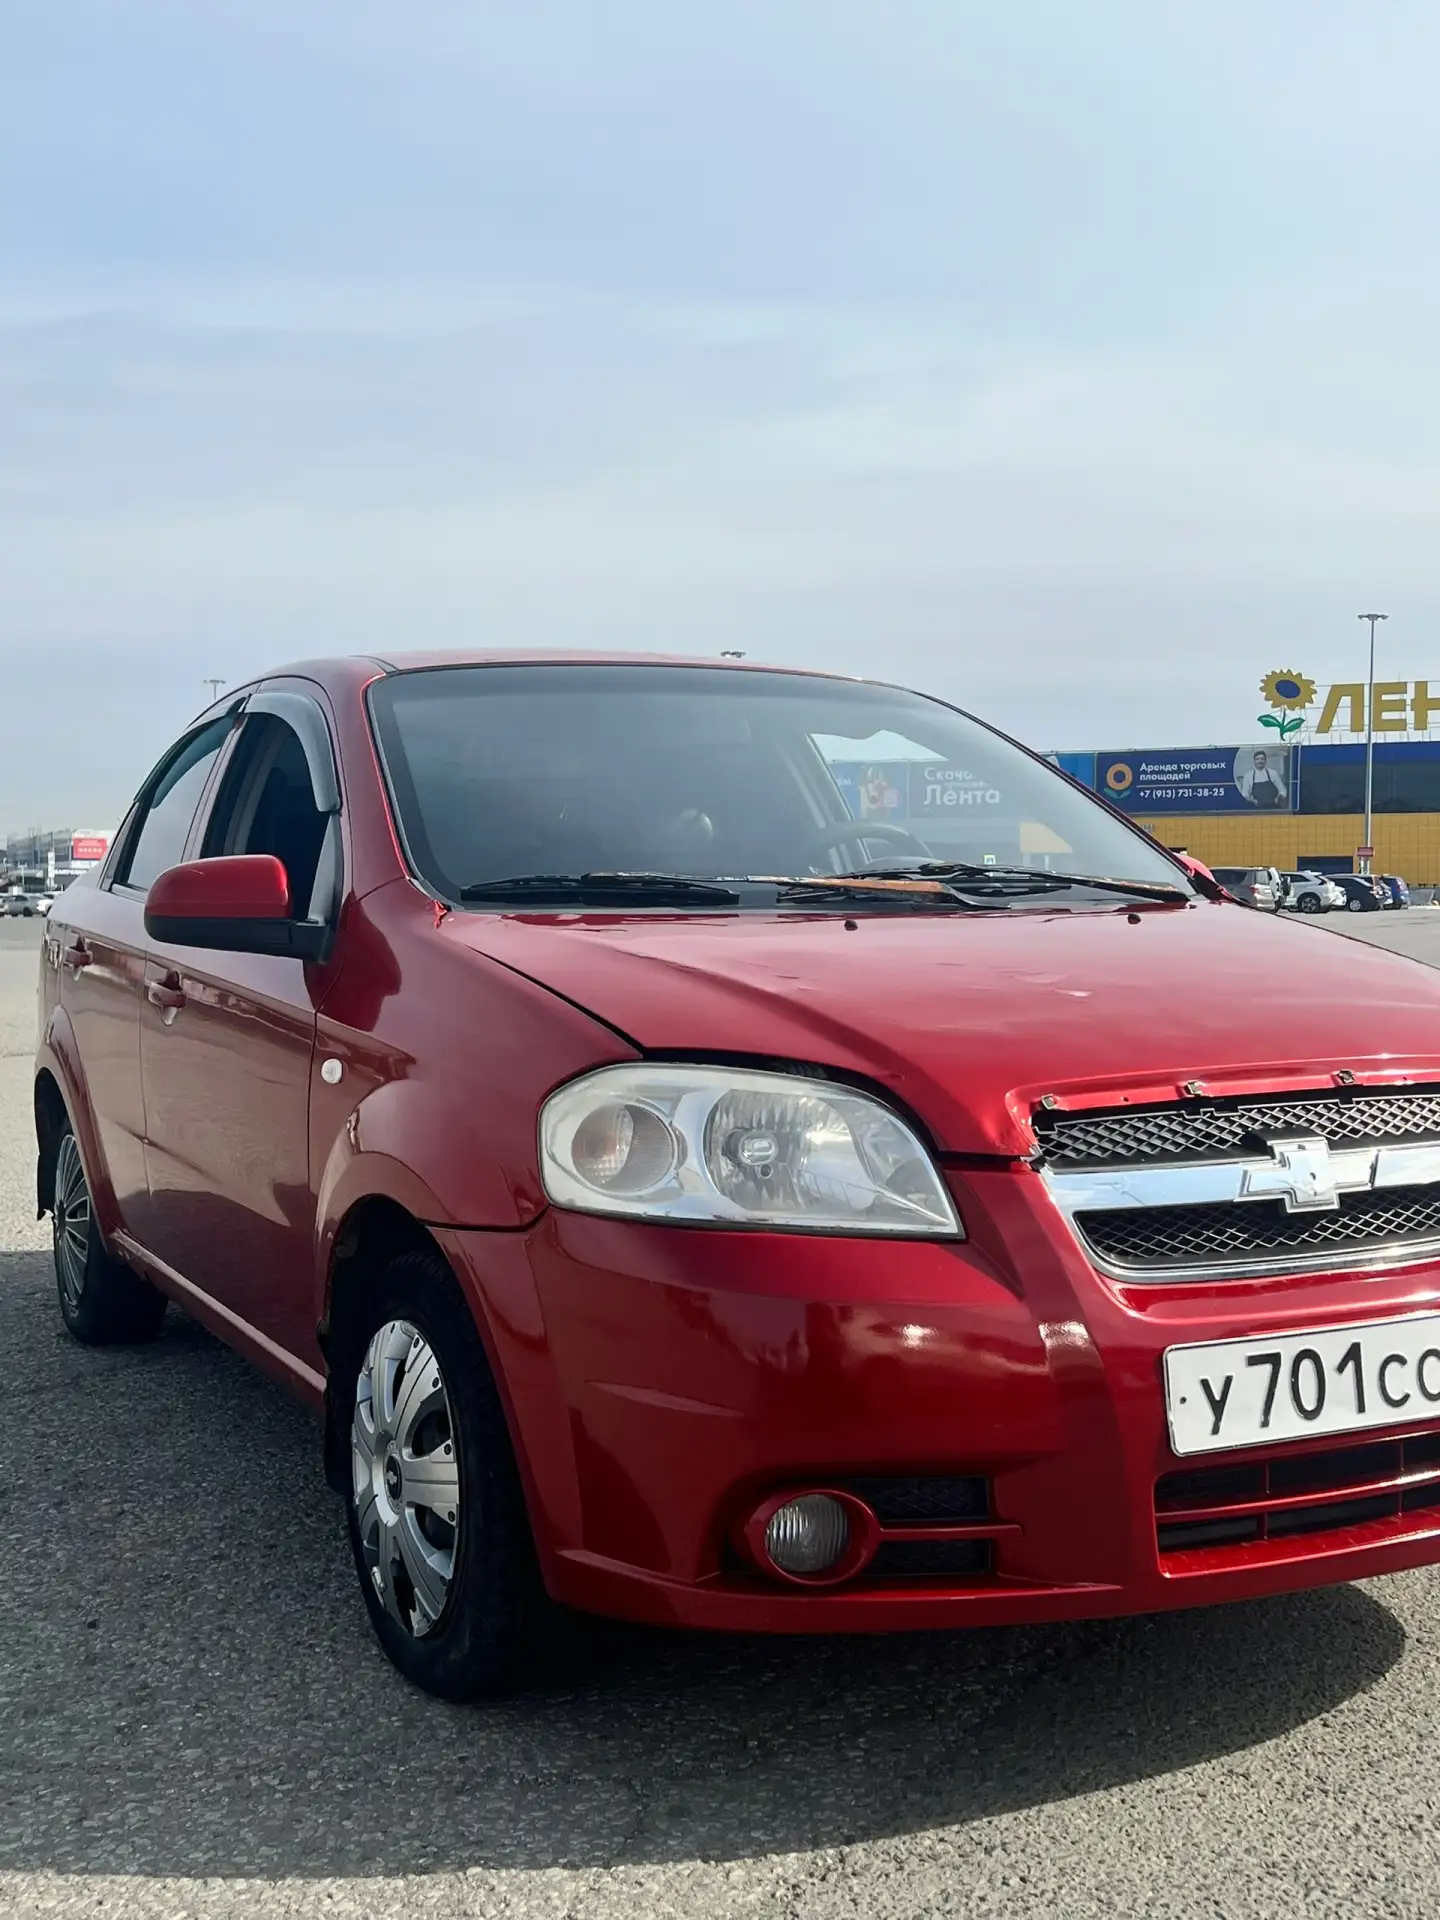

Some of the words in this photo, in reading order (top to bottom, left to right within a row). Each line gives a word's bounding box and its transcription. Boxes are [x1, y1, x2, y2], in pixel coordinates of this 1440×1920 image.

[1140, 762, 1178, 773] Аренда
[1180, 762, 1226, 772] торговых
[1140, 771, 1191, 781] площадей
[923, 784, 1000, 805] Лента
[1140, 790, 1151, 798] +7
[1152, 788, 1176, 799] (913)
[1177, 788, 1225, 797] 731-38-25
